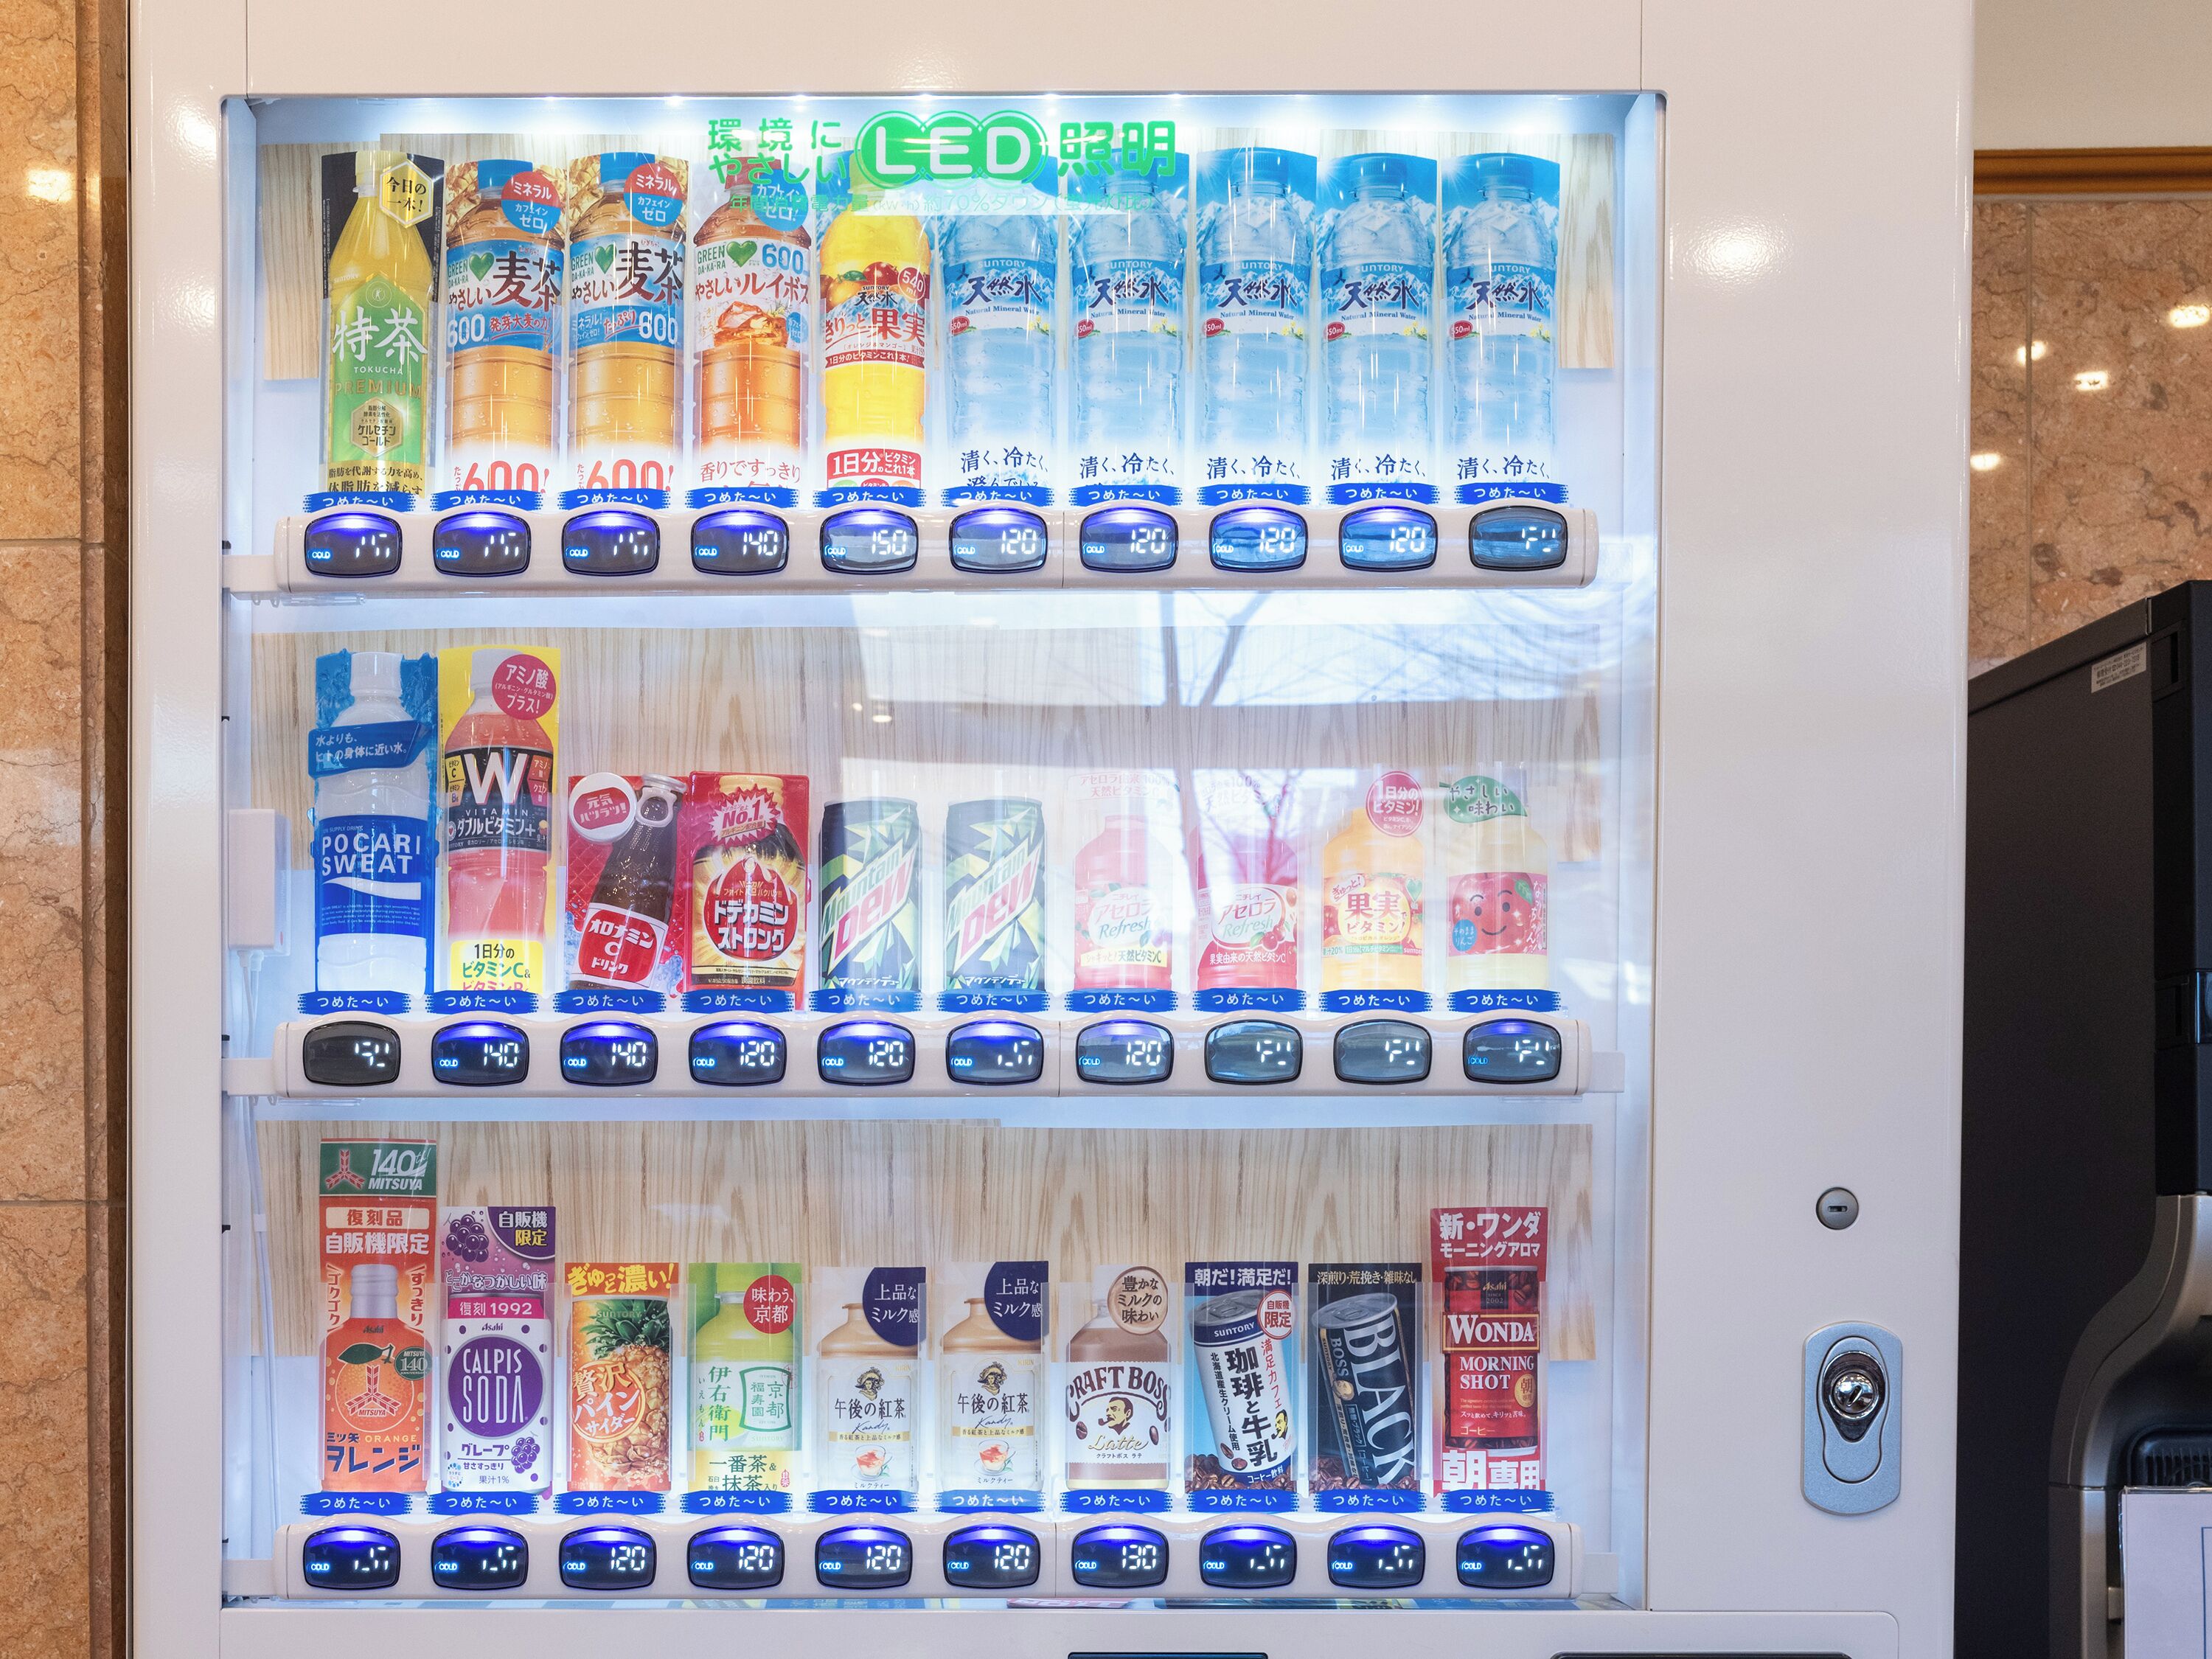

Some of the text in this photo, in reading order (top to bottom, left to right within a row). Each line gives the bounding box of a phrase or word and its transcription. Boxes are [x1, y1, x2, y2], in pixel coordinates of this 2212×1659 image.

[708, 118, 843, 152] 環境に
[876, 126, 1031, 175] LED
[1057, 120, 1176, 177] 照明
[709, 153, 847, 184] やさしい
[386, 176, 427, 194] 今日の
[512, 180, 552, 201] ミネラル
[635, 173, 675, 194] ミネラル
[387, 199, 423, 212] 一本!
[515, 203, 549, 216] カフェイン
[638, 195, 671, 210] カフェイン
[519, 213, 544, 230] ゼロ
[642, 207, 667, 223] ゼロ
[571, 251, 594, 271] GREEN
[697, 245, 726, 264] GREEN
[762, 243, 804, 274] 600
[978, 260, 1026, 268] SUNTORY
[1105, 260, 1153, 269] SUNTORY
[448, 259, 468, 278] GREEN
[1235, 262, 1284, 272] SUNTORY
[1355, 264, 1404, 274] SUNTORY
[1484, 264, 1531, 274] SUNTORY
[491, 251, 562, 313] 麦茶
[695, 273, 809, 305] やさしいルイボス
[962, 274, 1043, 305] 天然水
[1089, 277, 1169, 308] 天然水
[1217, 279, 1297, 310] 天然水
[1338, 280, 1419, 311] 天然水
[1466, 279, 1545, 310] 天然水
[1341, 312, 1367, 321] Natural
[1368, 311, 1399, 319] Mineral
[332, 305, 428, 366] 特茶
[447, 313, 485, 348] 600
[354, 366, 403, 375] TOKUCHA
[335, 378, 422, 399] PREMIUM
[358, 425, 397, 436] ケルセチン
[362, 436, 392, 446] ゴールド
[961, 446, 1048, 473] 清く、冷たく、
[1079, 452, 1175, 479] 清く、冷たく、
[700, 459, 801, 483] 香りですっきり
[743, 531, 778, 555] 140
[872, 530, 907, 555] 150
[1001, 529, 1036, 554] 120
[1131, 528, 1166, 554] 120
[1216, 545, 1234, 553] COLD
[1259, 527, 1295, 554] 120
[1390, 526, 1425, 553] 120
[312, 551, 331, 559] COLD
[827, 547, 846, 555] COLD
[506, 664, 549, 690] アミノ酸
[507, 694, 541, 714] プラス!
[316, 733, 357, 747] 水よりも、
[316, 742, 407, 763] ヒトの身体に近い水。
[463, 752, 529, 807] W
[586, 793, 613, 807] 元気
[1374, 781, 1419, 800] 1日分の
[1450, 785, 1509, 802] やさしい
[465, 808, 529, 817] VITAMIN
[1372, 800, 1419, 816] ビタミン!
[1468, 801, 1514, 815] 味わい
[322, 832, 421, 856] POCARI
[321, 852, 413, 876] SWEAT
[1236, 893, 1262, 902] ニチレイ
[714, 900, 789, 925] ドデカミン
[1218, 897, 1276, 925] アセロラ
[588, 919, 655, 949] オロナミン
[1222, 917, 1273, 939] Refresh
[604, 942, 622, 956] C
[717, 927, 785, 951] ストロング
[473, 944, 515, 959] 1日分の
[591, 956, 629, 975] ドリンク
[838, 975, 900, 987] マウンテンデュー
[439, 1059, 458, 1067] COLD
[484, 1043, 519, 1067] 140
[611, 1042, 647, 1066] 140
[740, 1041, 775, 1066] 120
[869, 1040, 904, 1066] 120
[1082, 1057, 1101, 1065] COLD
[1126, 1040, 1162, 1066] 120
[368, 1178, 423, 1190] MITSUYA
[347, 1209, 403, 1227] 復刻品
[498, 1211, 548, 1228] 自販機
[1439, 1211, 1542, 1240] 新・ワンダ
[325, 1233, 430, 1255] 自販機限定
[515, 1231, 547, 1246] 限定
[1440, 1241, 1540, 1258] モーニングアロマ
[567, 1263, 675, 1295] ぎゅっと濃い!
[996, 1278, 1039, 1295] 上品な
[1122, 1276, 1158, 1292] 豊かな
[1194, 1268, 1291, 1287] 朝だ!満足だ!
[1483, 1281, 1507, 1290] Asahi
[411, 1271, 426, 1326] すっきり
[751, 1287, 795, 1304] 味わう、
[875, 1284, 917, 1301] 上品な
[1117, 1294, 1162, 1306] ミルクの
[460, 1301, 532, 1315] 復刻 1992
[753, 1305, 788, 1324] 京都
[992, 1301, 1043, 1318] ミルク感
[1267, 1300, 1290, 1310] 自販機
[872, 1307, 919, 1324] ミルク感
[1121, 1310, 1159, 1324] 味わい
[1264, 1311, 1292, 1328] 限定
[481, 1323, 503, 1331] Asahi
[1214, 1322, 1256, 1338] SUNTORY
[1447, 1315, 1535, 1344] WONDA
[463, 1349, 522, 1374] CALPIS
[1329, 1337, 1349, 1377] BOSS
[1460, 1356, 1534, 1371] MORNING
[1460, 1374, 1511, 1390] SHOT
[462, 1375, 524, 1424] SODA
[708, 1366, 731, 1442] 伊右衛門
[751, 1382, 765, 1417] 福寿園
[766, 1381, 784, 1419] 京都
[957, 1392, 1028, 1414] 午後の紅茶
[1128, 1366, 1167, 1422] BOSS
[1343, 1315, 1416, 1485] BLACK
[358, 1408, 386, 1416] MITSUYA
[574, 1389, 640, 1423] パイン
[835, 1398, 905, 1419] 午後の紅茶
[1225, 1346, 1278, 1467] 珈琲と牛乳
[585, 1413, 636, 1436] サイダー
[1460, 1426, 1495, 1436] コーヒー
[462, 1443, 510, 1457] グレープ
[1088, 1434, 1150, 1451] Latte
[463, 1461, 504, 1470] 甘さすっきり
[1442, 1450, 1540, 1490] 朝専用
[479, 1475, 509, 1484] 果汁1%
[611, 1546, 646, 1571] 120
[739, 1545, 774, 1571] 120
[866, 1545, 902, 1570] 120
[995, 1545, 1030, 1570] 120
[1122, 1545, 1156, 1569] 130
